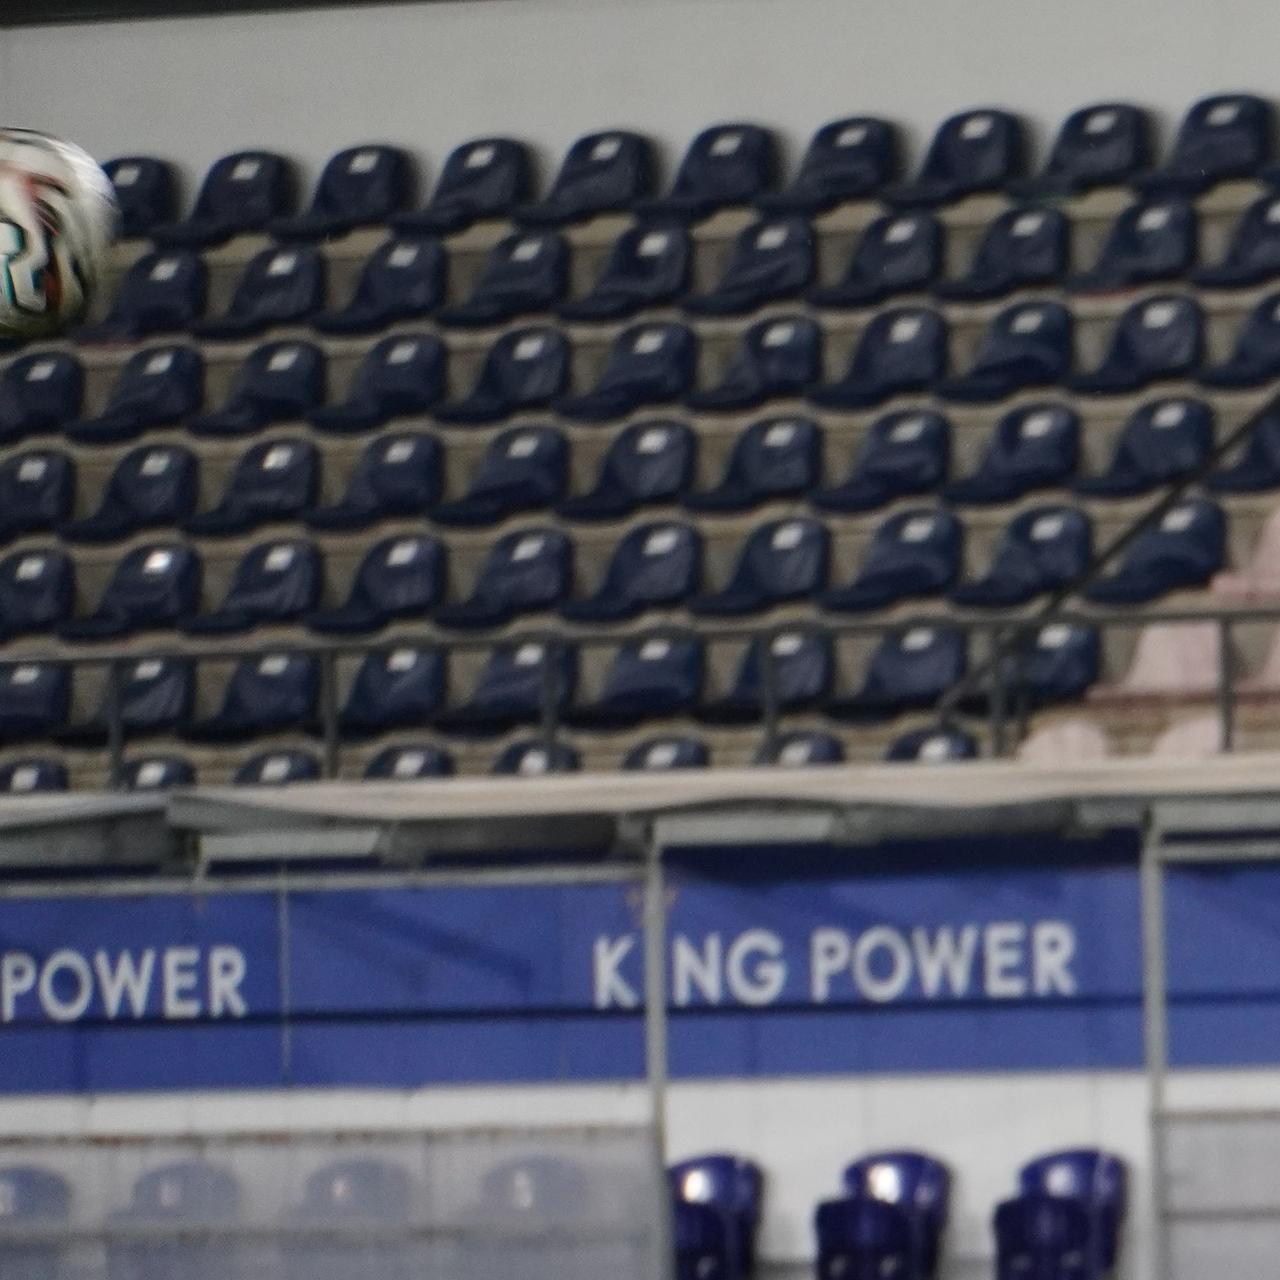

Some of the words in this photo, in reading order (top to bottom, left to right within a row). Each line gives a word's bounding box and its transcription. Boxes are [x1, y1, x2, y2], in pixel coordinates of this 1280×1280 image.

[1, 946, 247, 1023] POWER
[592, 929, 788, 1007] KNG
[810, 921, 1077, 1002] POWER
